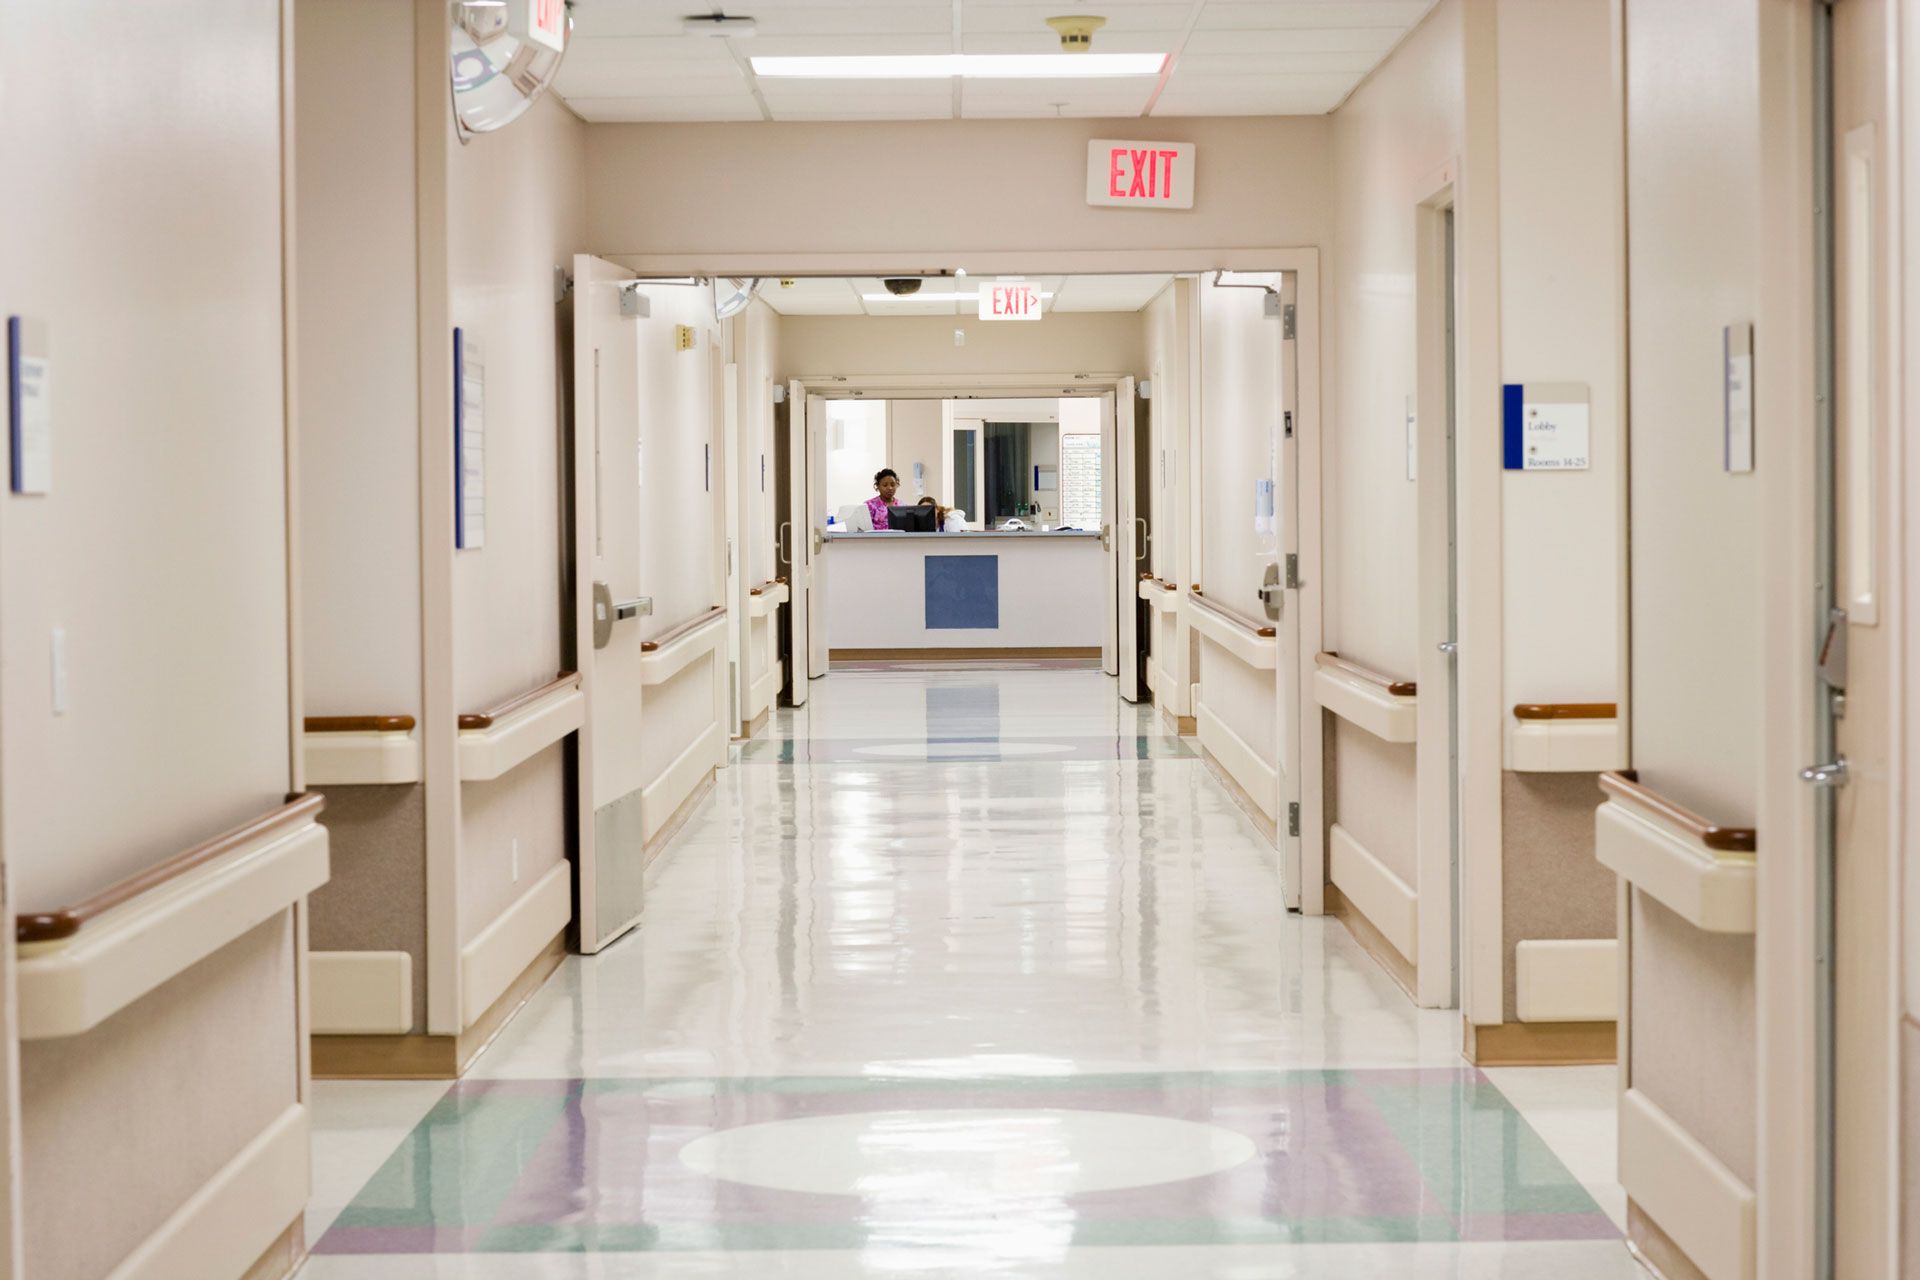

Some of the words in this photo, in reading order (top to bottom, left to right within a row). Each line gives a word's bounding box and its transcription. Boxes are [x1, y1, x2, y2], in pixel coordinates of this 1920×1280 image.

[1109, 148, 1178, 199] EXIT
[992, 287, 1031, 315] EXIT
[1528, 421, 1557, 432] Lobby
[1528, 457, 1560, 467] Rooms
